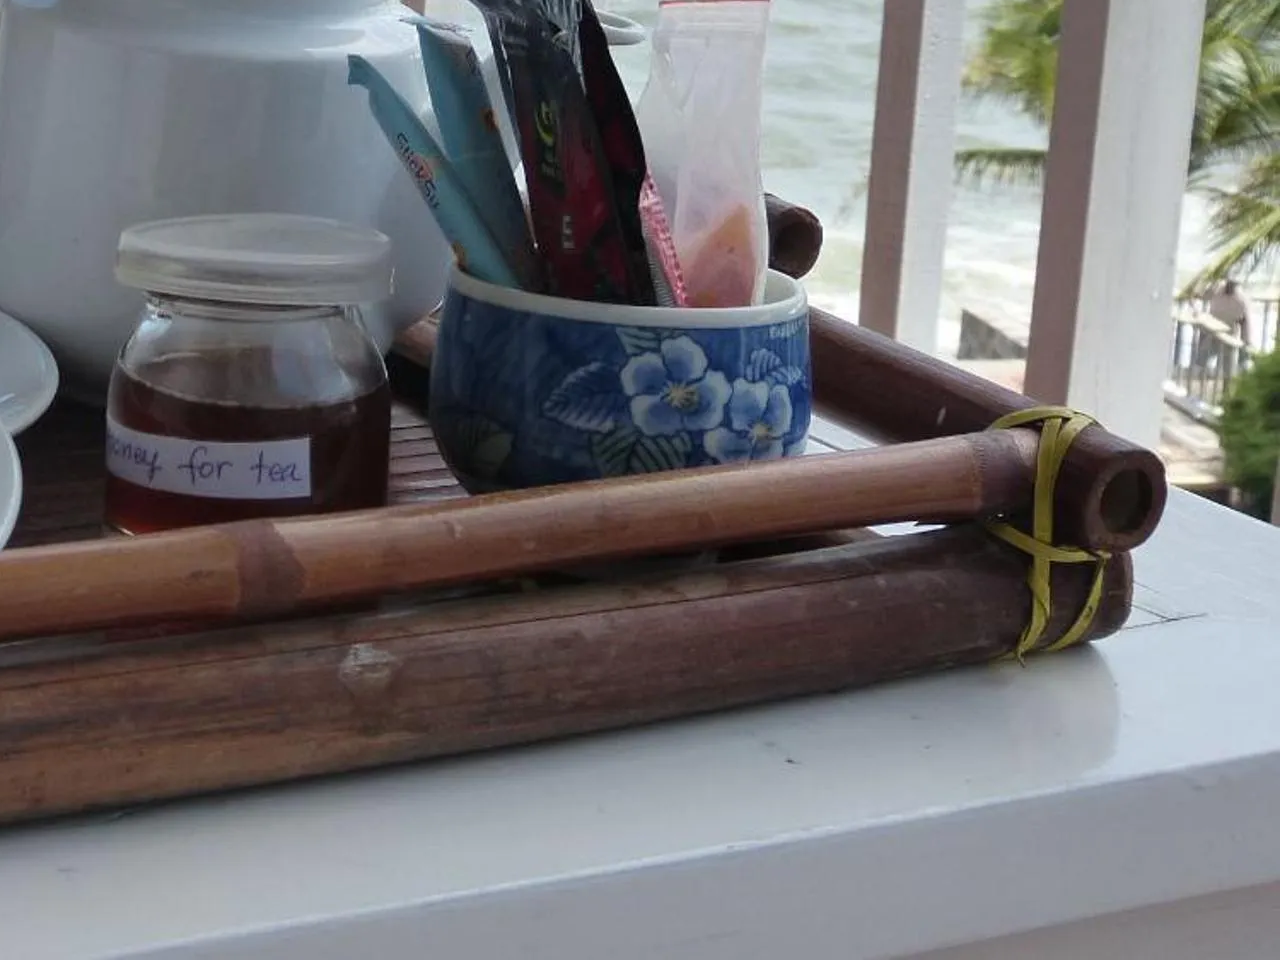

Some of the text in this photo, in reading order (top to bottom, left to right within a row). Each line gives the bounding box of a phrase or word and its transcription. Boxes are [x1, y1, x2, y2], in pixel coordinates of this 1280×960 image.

[107, 429, 303, 486] oney for tea
